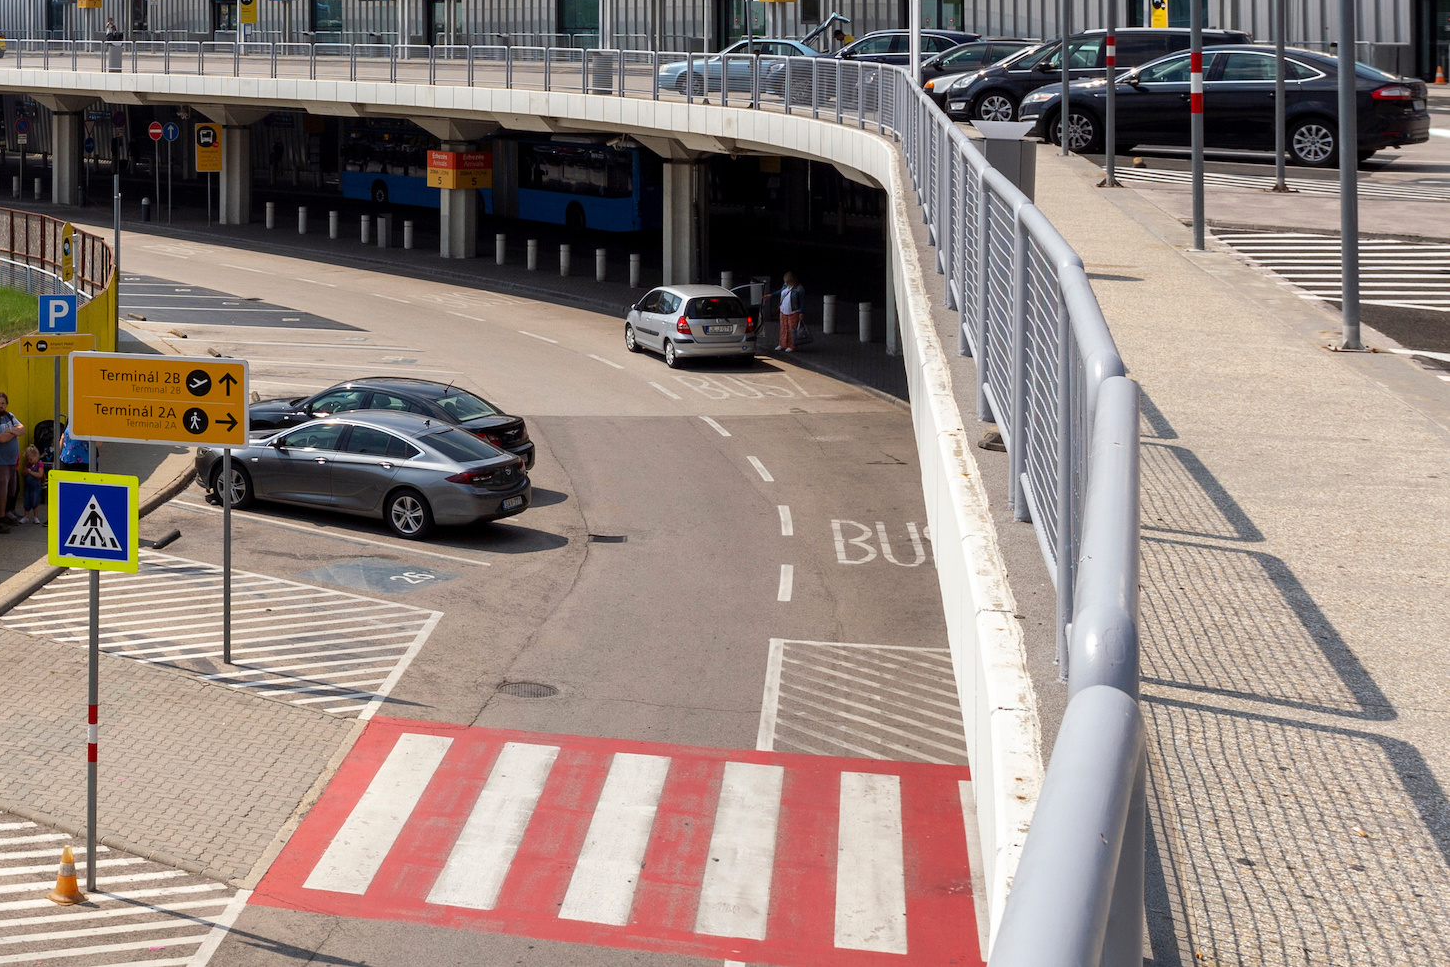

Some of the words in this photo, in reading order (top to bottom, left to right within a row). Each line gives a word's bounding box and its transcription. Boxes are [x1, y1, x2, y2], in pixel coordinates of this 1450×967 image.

[438, 176, 443, 185] 5
[471, 177, 477, 186] 5
[49, 299, 70, 328] P
[100, 369, 159, 383] Terminál
[164, 372, 181, 384] 2B
[132, 385, 167, 394] Terminal
[671, 375, 795, 400] BUS
[94, 403, 153, 418] Terminál
[158, 407, 176, 419] 2A
[126, 419, 162, 429] Terminal
[165, 421, 177, 429] 2A
